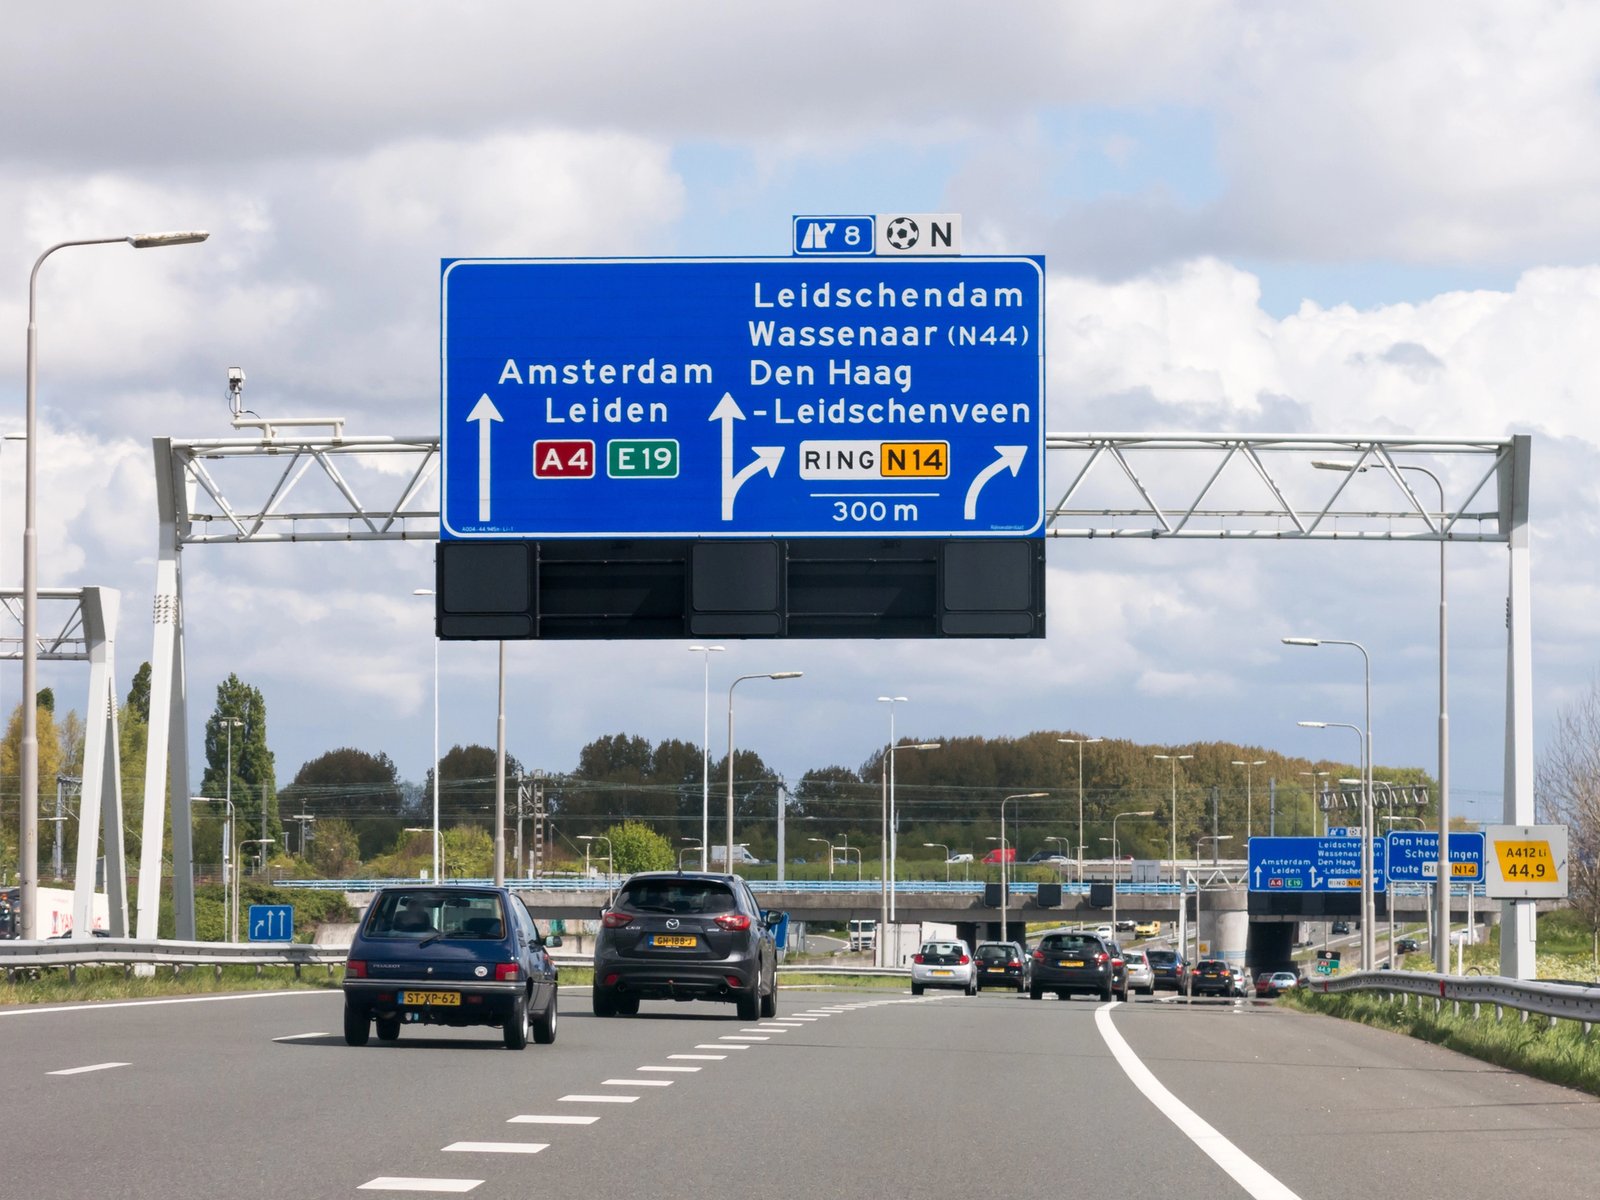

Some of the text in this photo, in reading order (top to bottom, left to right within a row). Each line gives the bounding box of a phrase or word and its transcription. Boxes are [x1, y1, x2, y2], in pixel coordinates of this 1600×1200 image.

[844, 226, 860, 245] 8
[931, 222, 951, 246] N
[755, 282, 1023, 308] Leidschendam
[749, 321, 1028, 347] Wassenaar (N44)
[498, 358, 712, 384] Amsterdam
[751, 360, 912, 393] Den Haag
[546, 397, 667, 423] Leiden
[754, 399, 1030, 424] -Leidschenveen
[541, 448, 588, 470] A4
[619, 447, 672, 470] E19
[805, 449, 942, 470] RING N14
[833, 502, 918, 521] 300 m
[1392, 837, 1411, 846] Den
[1336, 859, 1355, 867] Haag
[1507, 848, 1535, 857] A412
[1392, 865, 1419, 873] route
[1508, 864, 1545, 878] 44,9
[408, 993, 456, 1004] ST-XP-62
